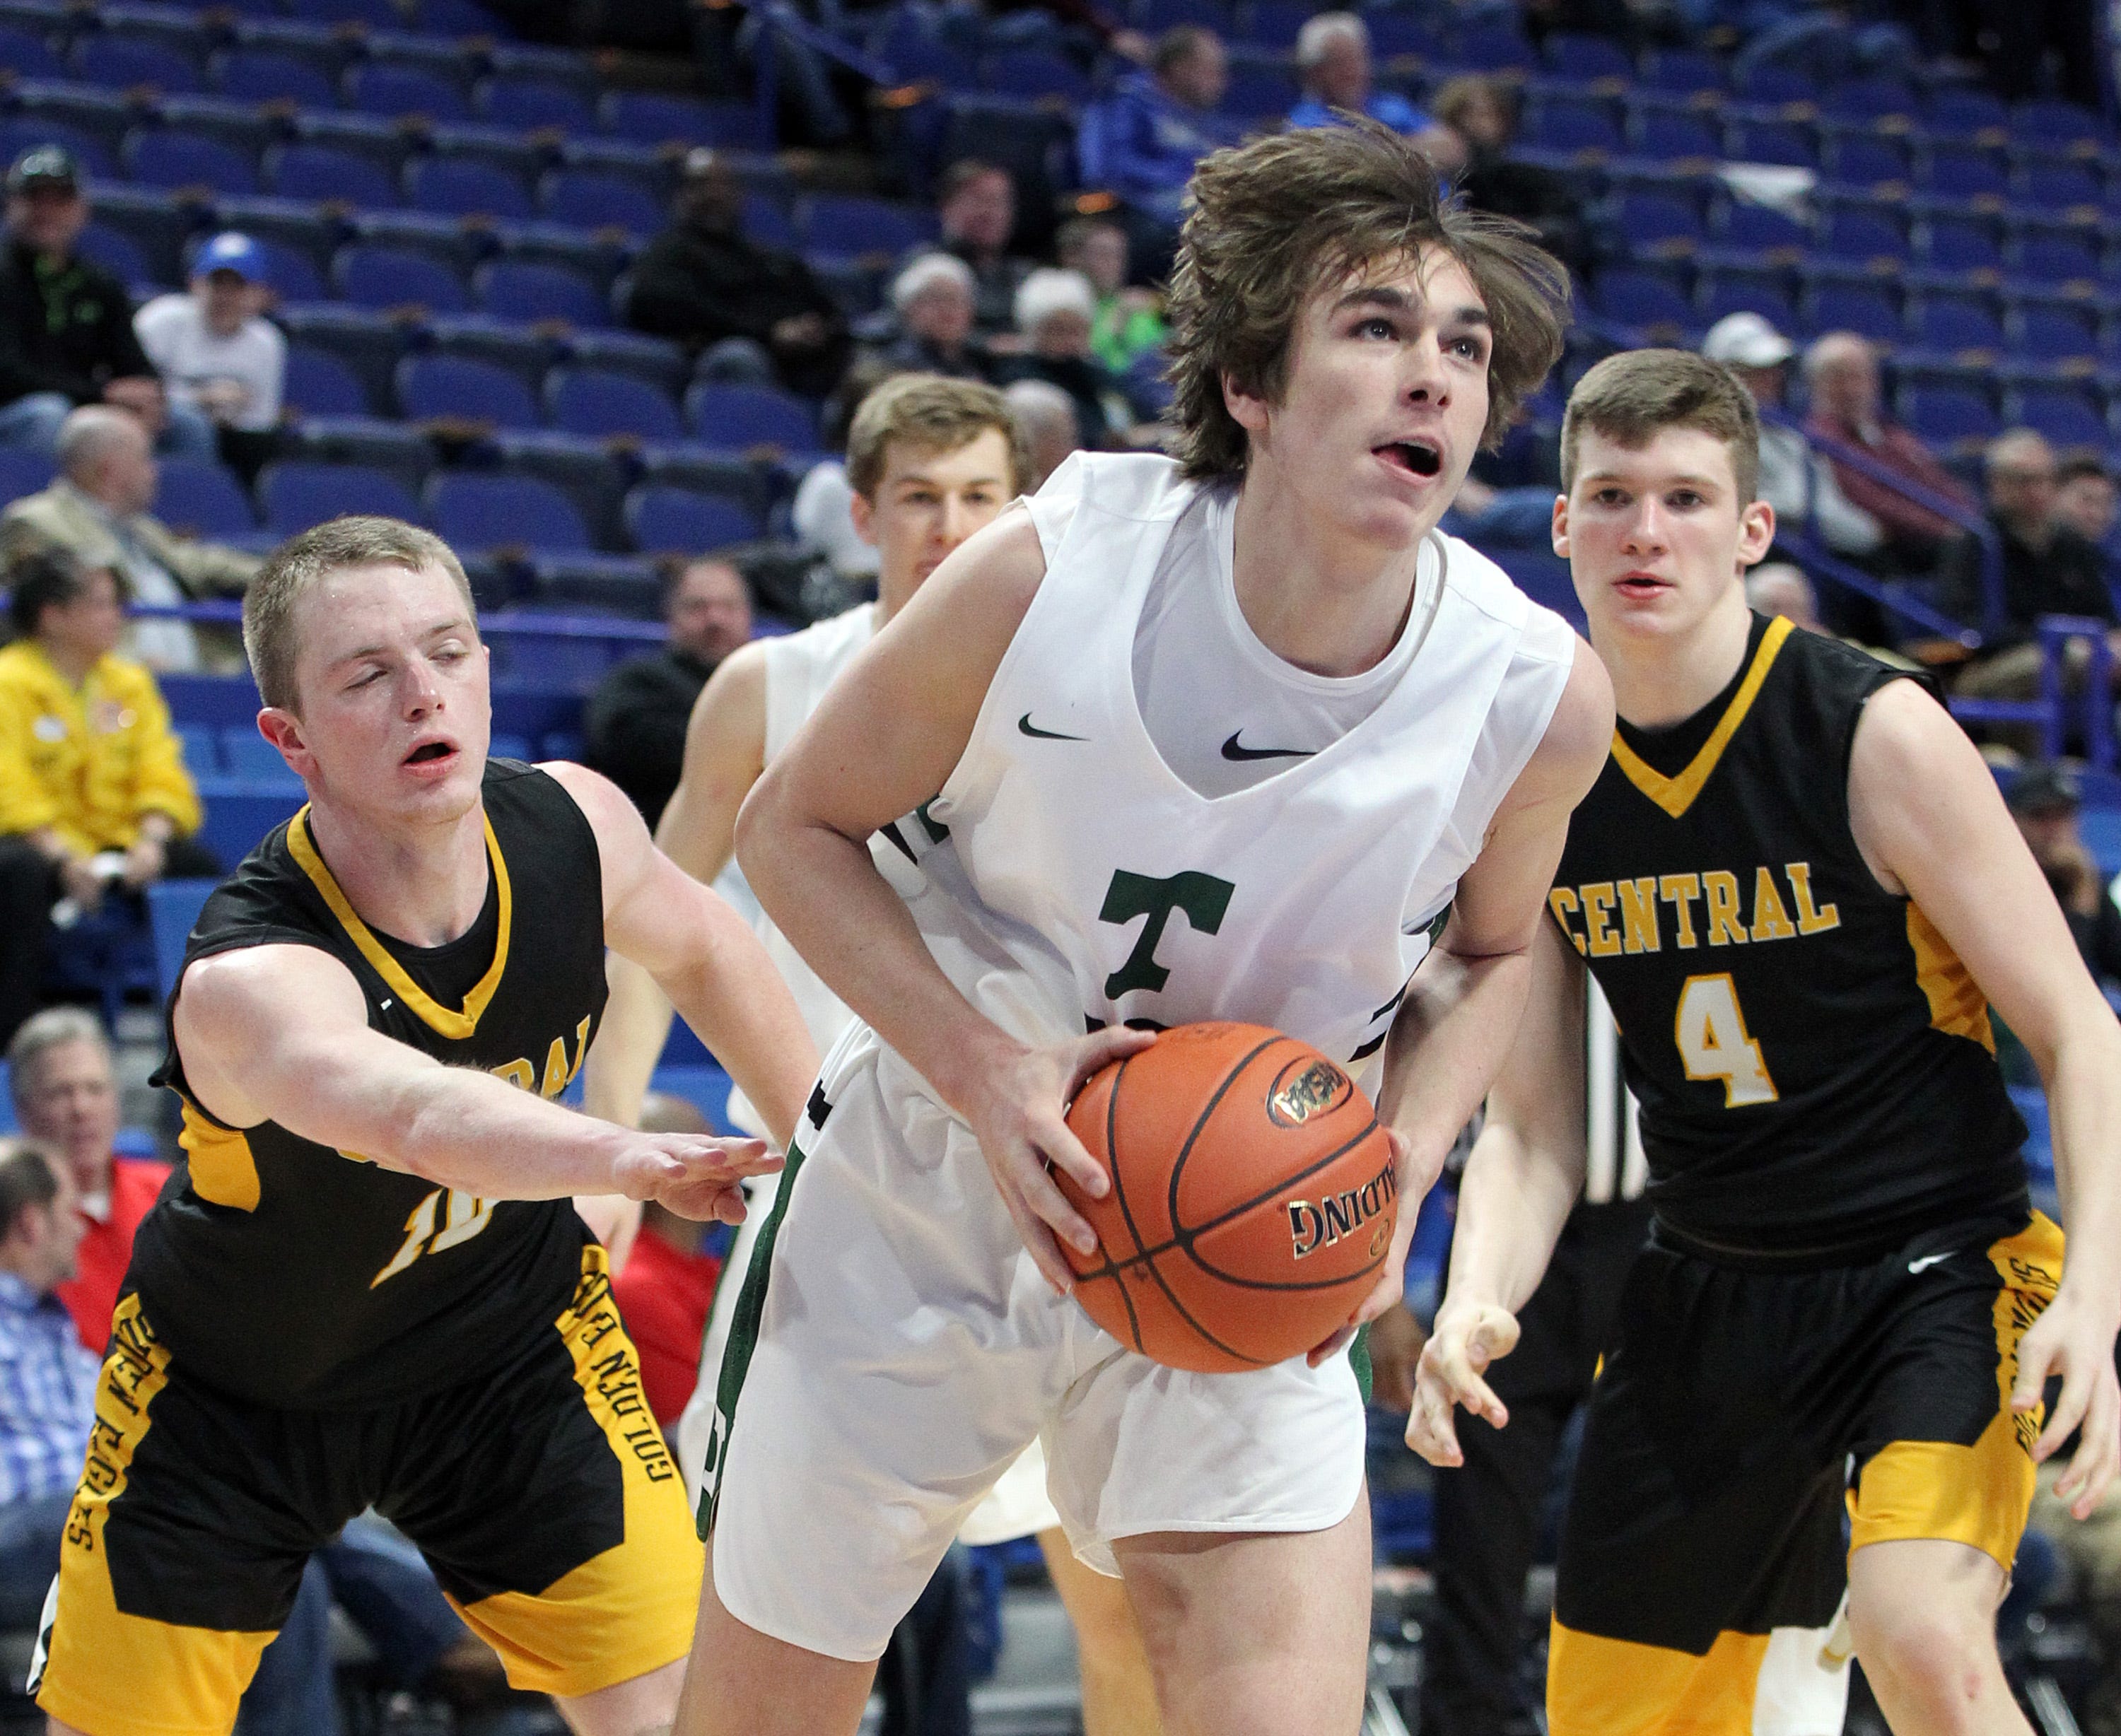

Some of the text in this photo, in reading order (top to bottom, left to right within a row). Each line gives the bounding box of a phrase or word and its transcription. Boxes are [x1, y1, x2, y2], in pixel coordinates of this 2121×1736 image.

[1098, 869, 1236, 1001] T
[1548, 862, 1841, 957] CENTRAL
[1674, 973, 1779, 1109] 4
